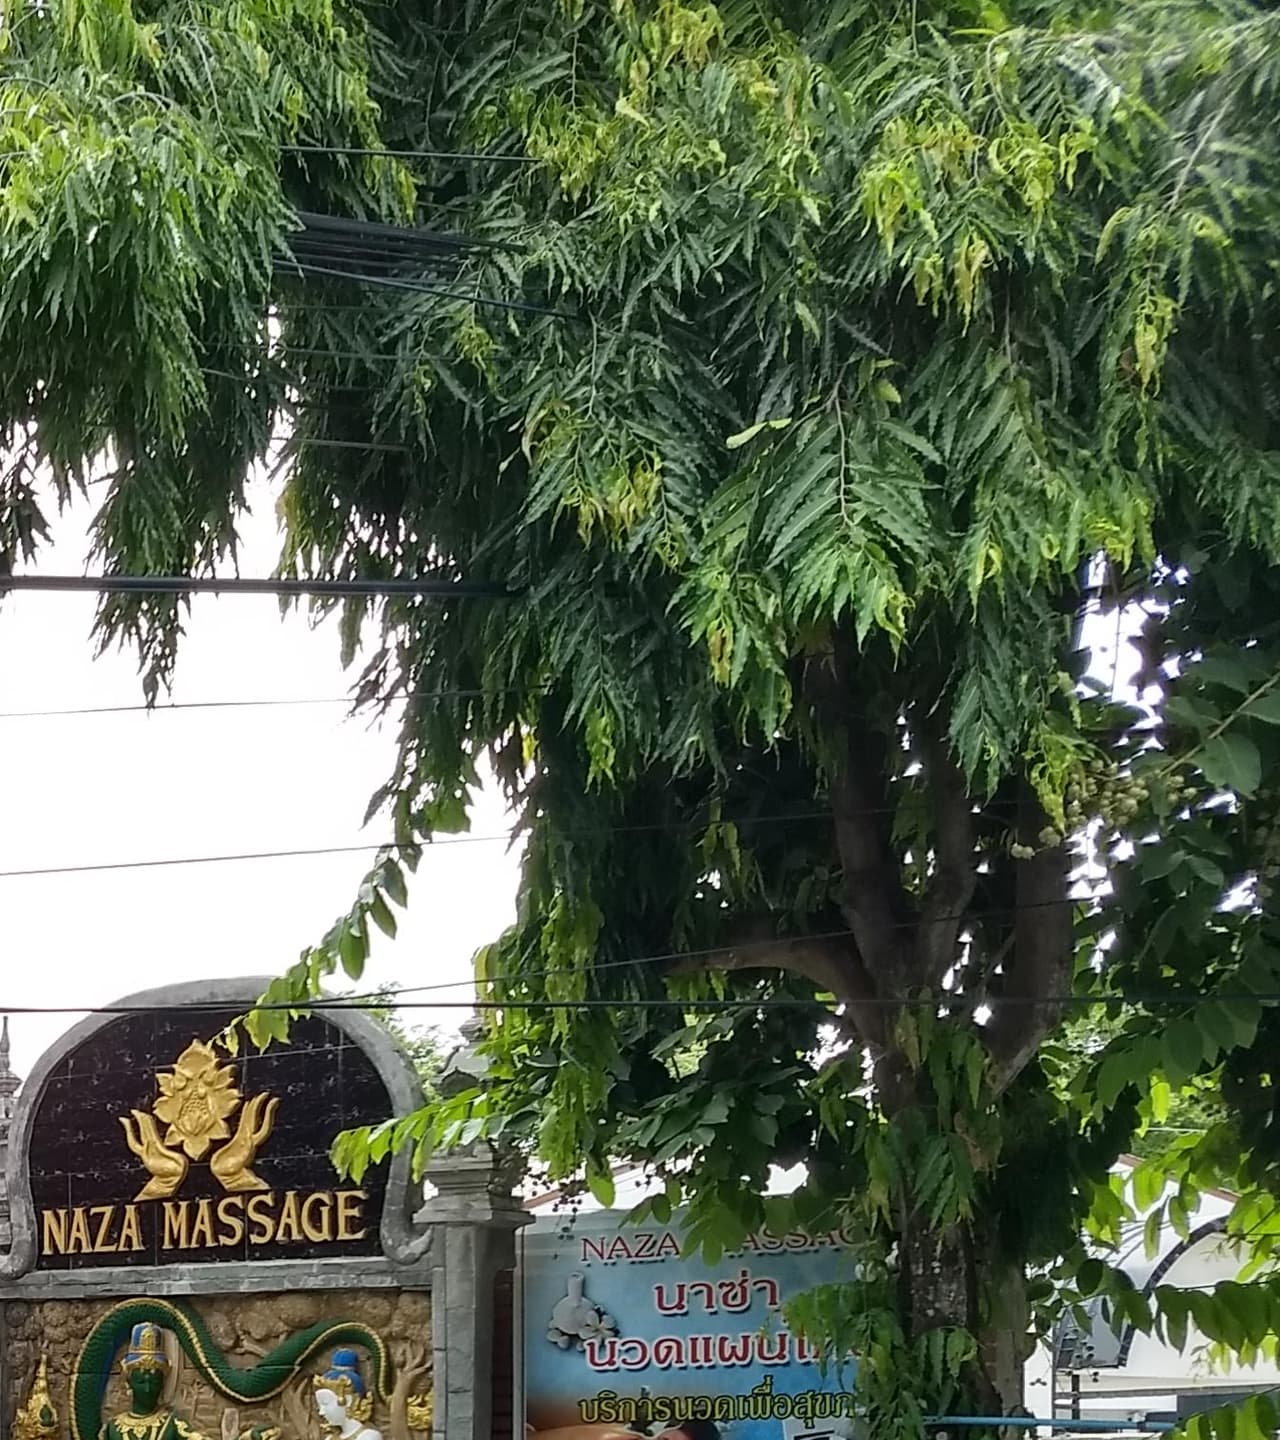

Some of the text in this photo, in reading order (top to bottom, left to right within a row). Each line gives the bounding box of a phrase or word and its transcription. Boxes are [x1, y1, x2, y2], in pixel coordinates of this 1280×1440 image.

[42, 1189, 370, 1256] NAZA MASSAGE
[580, 1231, 682, 1263] NAZA
[653, 1269, 781, 1314] นาซ่า
[578, 1375, 857, 1430] บริการนวดเพื่อสุขภ
